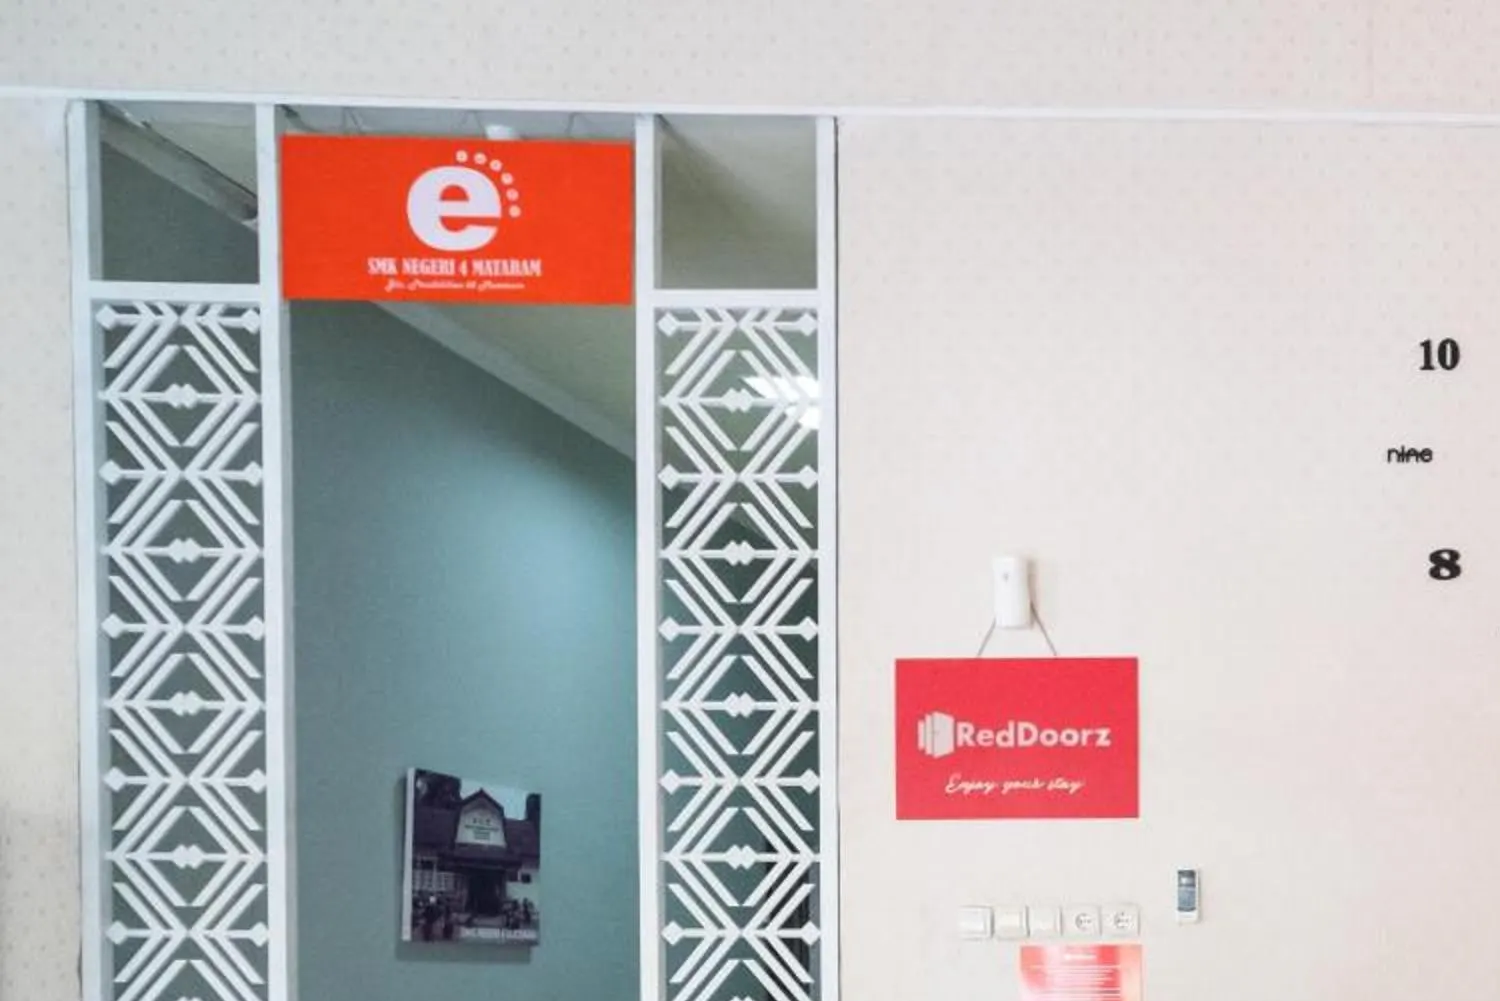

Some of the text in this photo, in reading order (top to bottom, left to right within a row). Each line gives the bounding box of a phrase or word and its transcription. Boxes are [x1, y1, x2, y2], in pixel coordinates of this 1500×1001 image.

[367, 256, 543, 278] SMK NEGERI 4 MATARAM
[1418, 337, 1461, 372] 10
[1387, 445, 1433, 464] nine
[1428, 548, 1462, 581] 8
[956, 720, 1112, 747] RedDoorz
[945, 773, 1084, 794] Enjoy your stay
